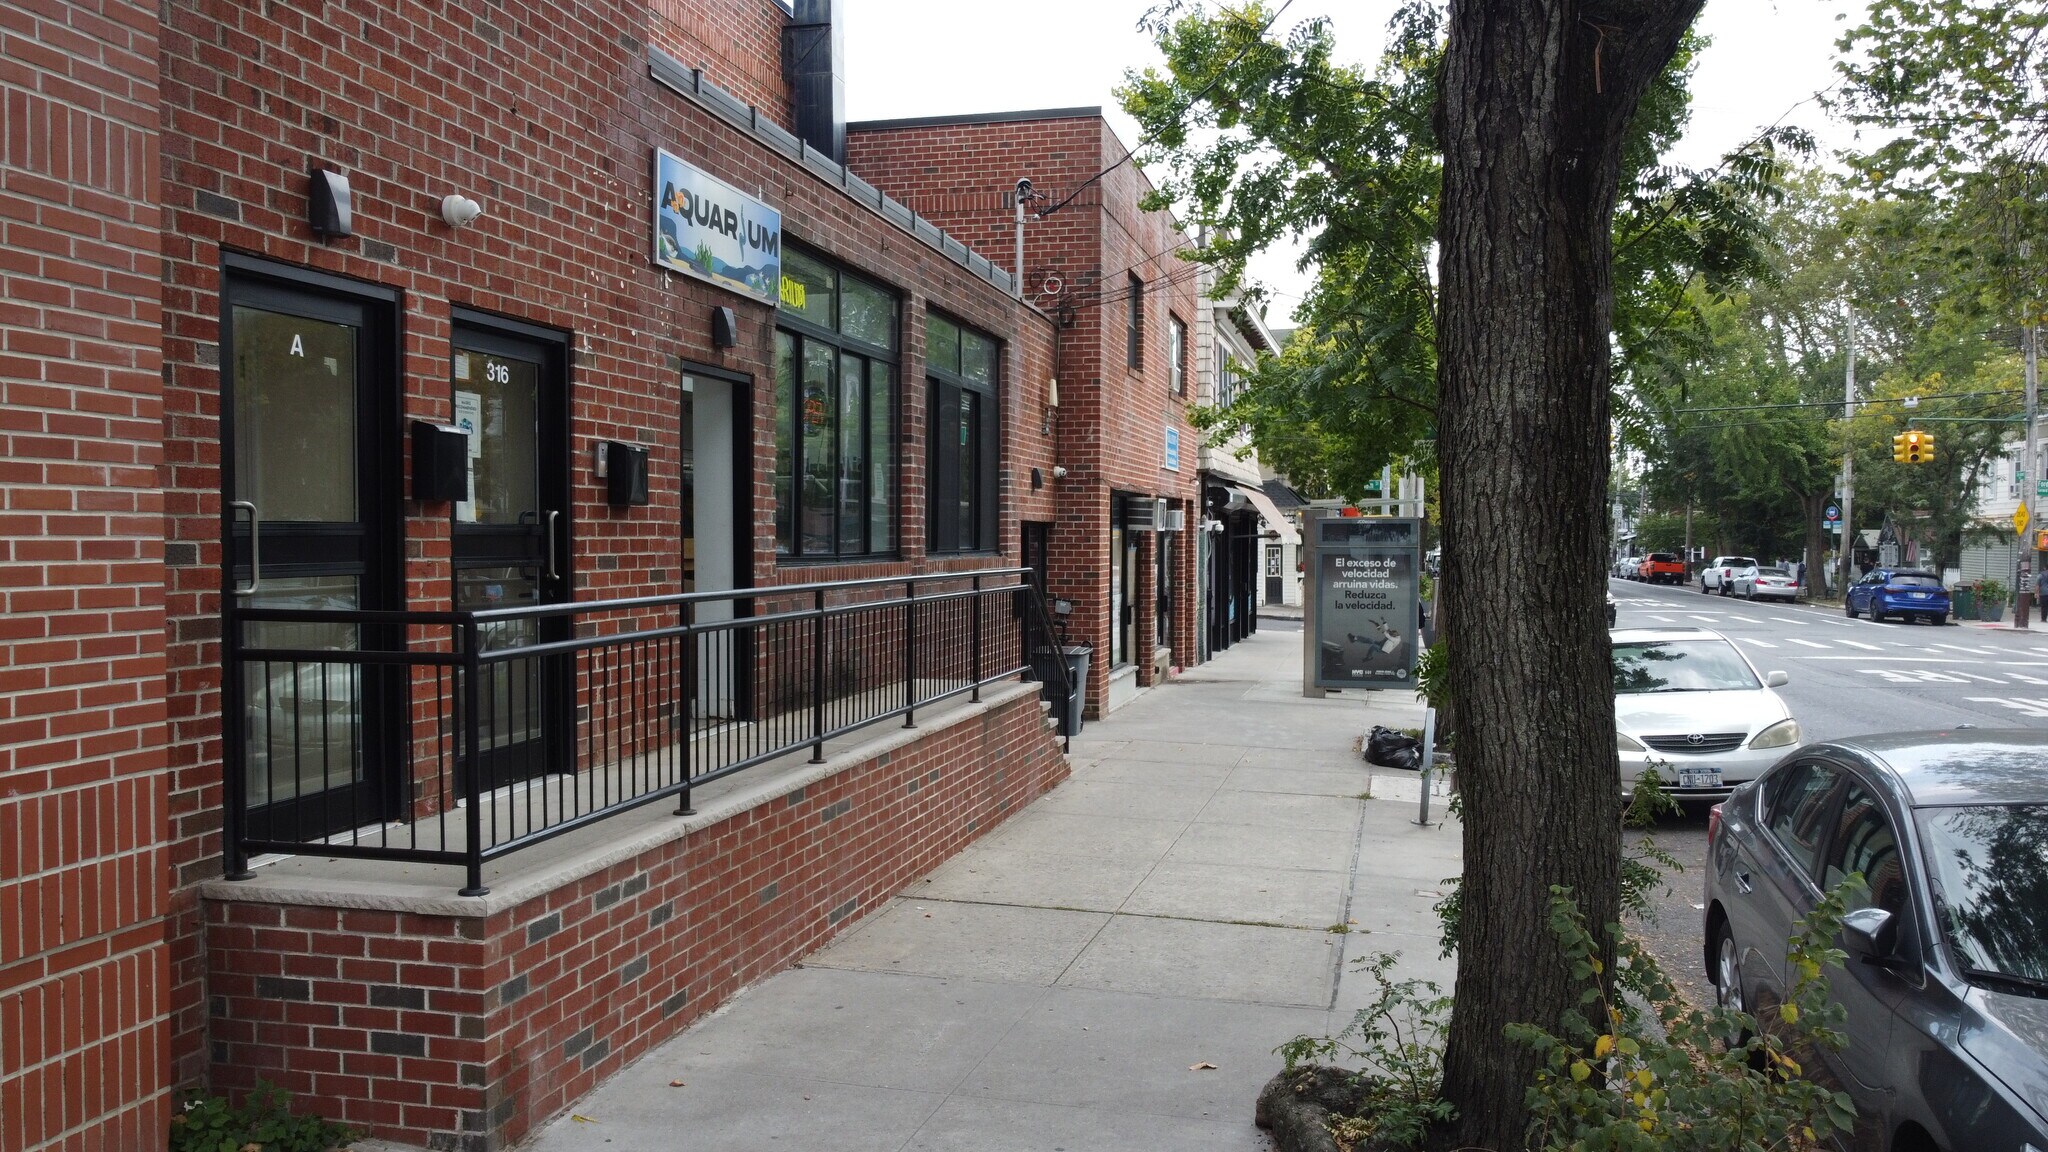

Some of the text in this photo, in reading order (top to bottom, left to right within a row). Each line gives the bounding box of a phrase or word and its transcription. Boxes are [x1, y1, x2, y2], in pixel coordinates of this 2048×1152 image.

[661, 181, 778, 260] AQUARIUM
[290, 334, 304, 357] A
[486, 363, 509, 384] 316
[1335, 557, 1397, 568] El exceso de
[1341, 568, 1390, 578] velocidad
[1333, 579, 1398, 589] arruina vidas.
[1345, 590, 1387, 600] Reduzca
[1335, 600, 1396, 610] la velocidad.
